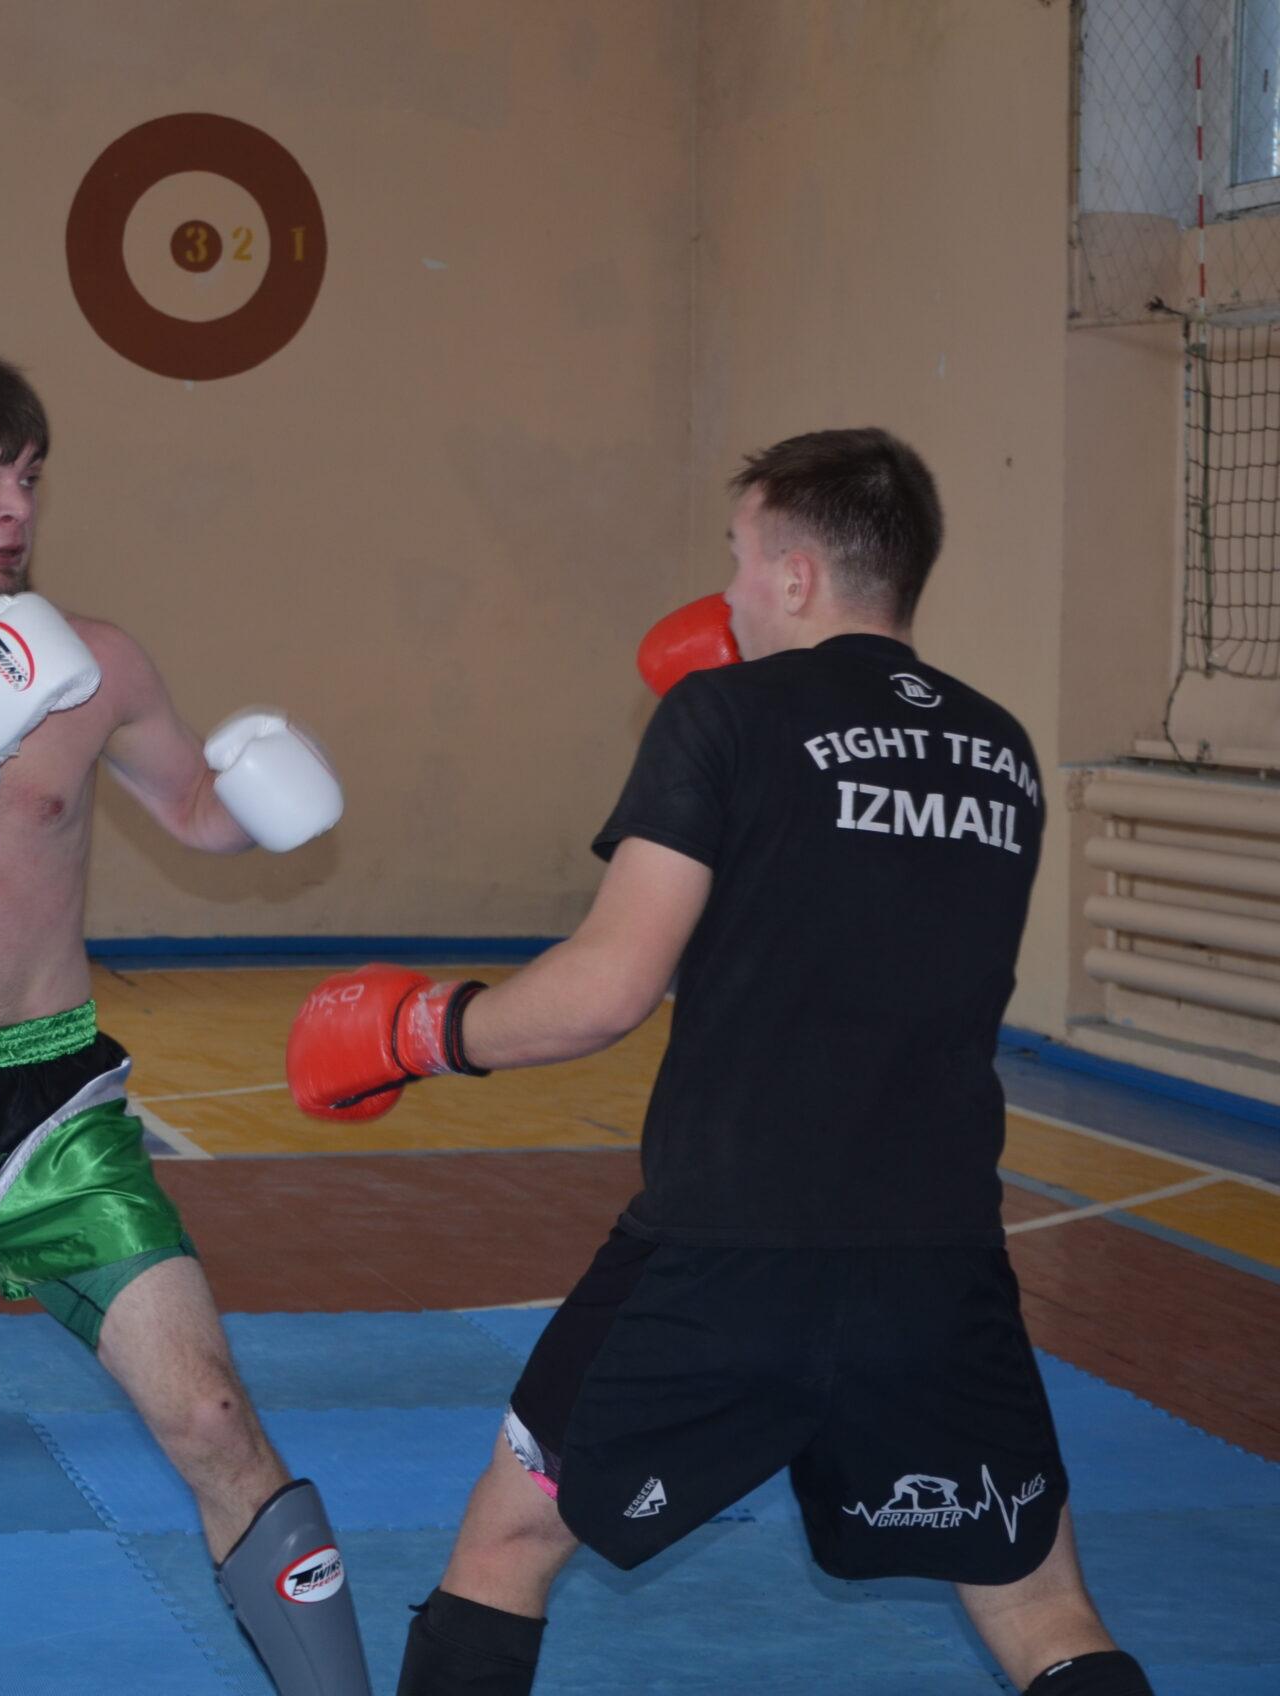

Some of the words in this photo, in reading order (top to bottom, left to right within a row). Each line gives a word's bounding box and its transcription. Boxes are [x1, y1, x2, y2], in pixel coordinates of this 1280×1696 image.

[185, 226, 208, 262] 3
[232, 226, 254, 260] 2
[290, 226, 306, 261] 1
[803, 727, 929, 771] FIGHT
[943, 732, 1038, 807] TEAM
[836, 780, 1022, 855] IZMAIL
[623, 1476, 657, 1517] BERSERK
[877, 1511, 963, 1529] GRAPPLER
